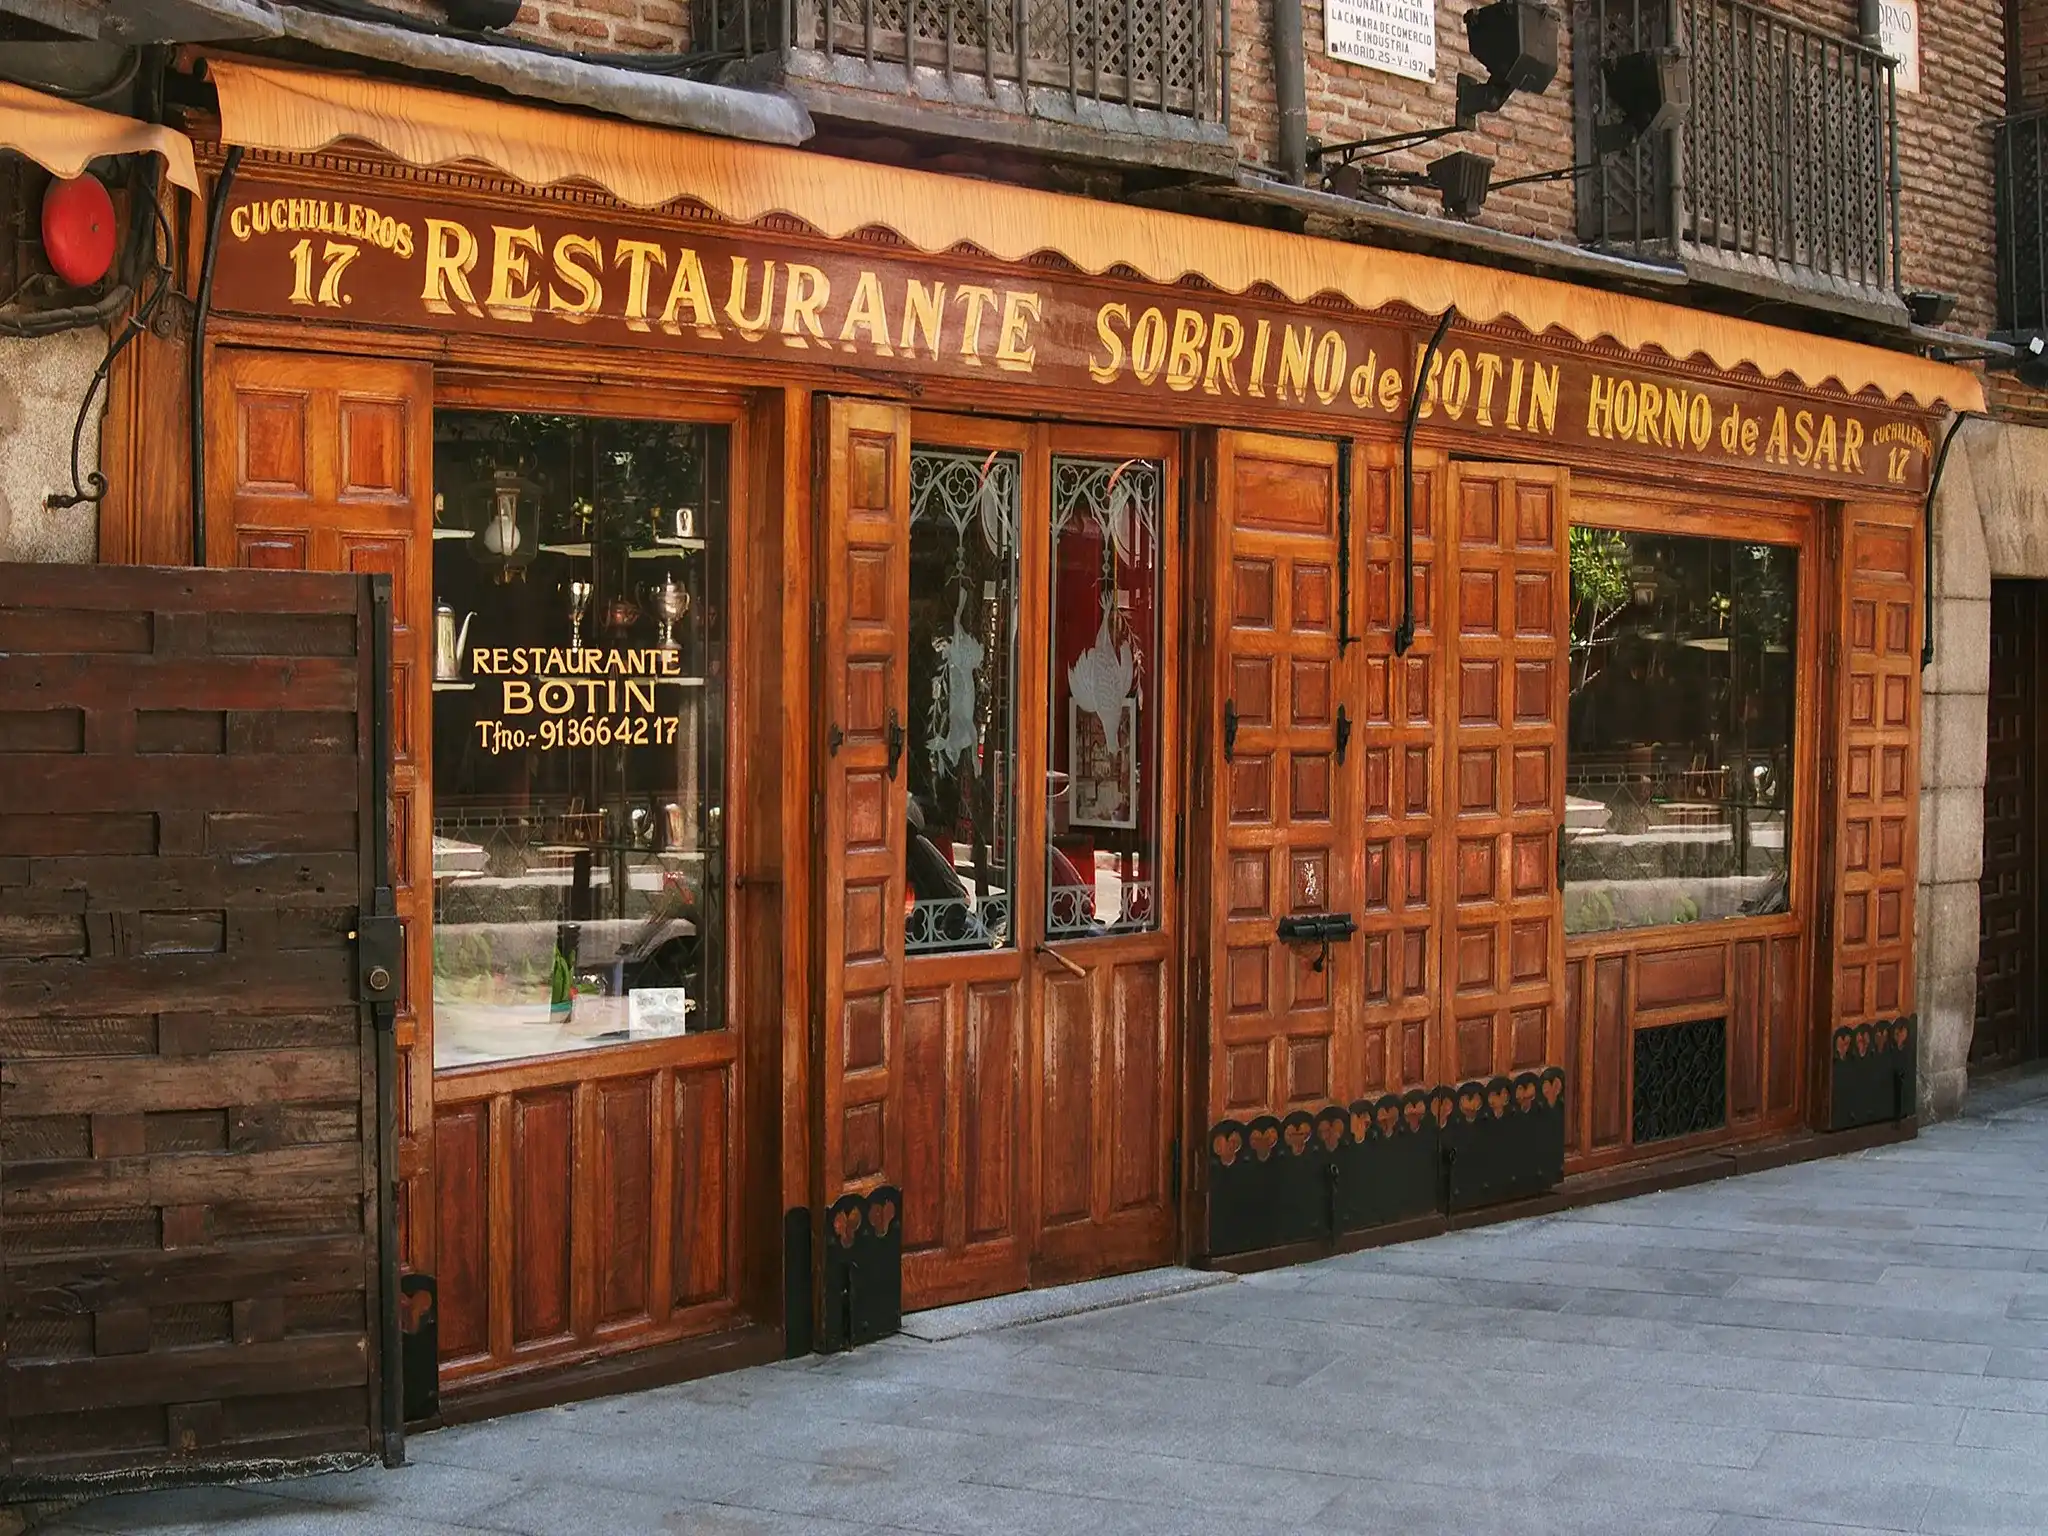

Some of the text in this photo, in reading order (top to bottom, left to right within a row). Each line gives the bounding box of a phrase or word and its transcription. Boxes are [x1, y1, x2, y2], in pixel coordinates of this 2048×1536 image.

[1386, 3, 1391, 16] Y
[1879, 3, 1912, 33] ORNO
[1332, 8, 1432, 46] LA CAMARA DE COMERCIO
[1356, 30, 1362, 41] E
[1882, 31, 1894, 45] DE
[230, 198, 415, 259] CUCHILLEROS
[420, 217, 1864, 475] RESTAURANTE SOBRINO de BOTIN HORNO de ASAR
[472, 646, 681, 675] RESTAURANTE
[502, 679, 657, 715] BOTIN
